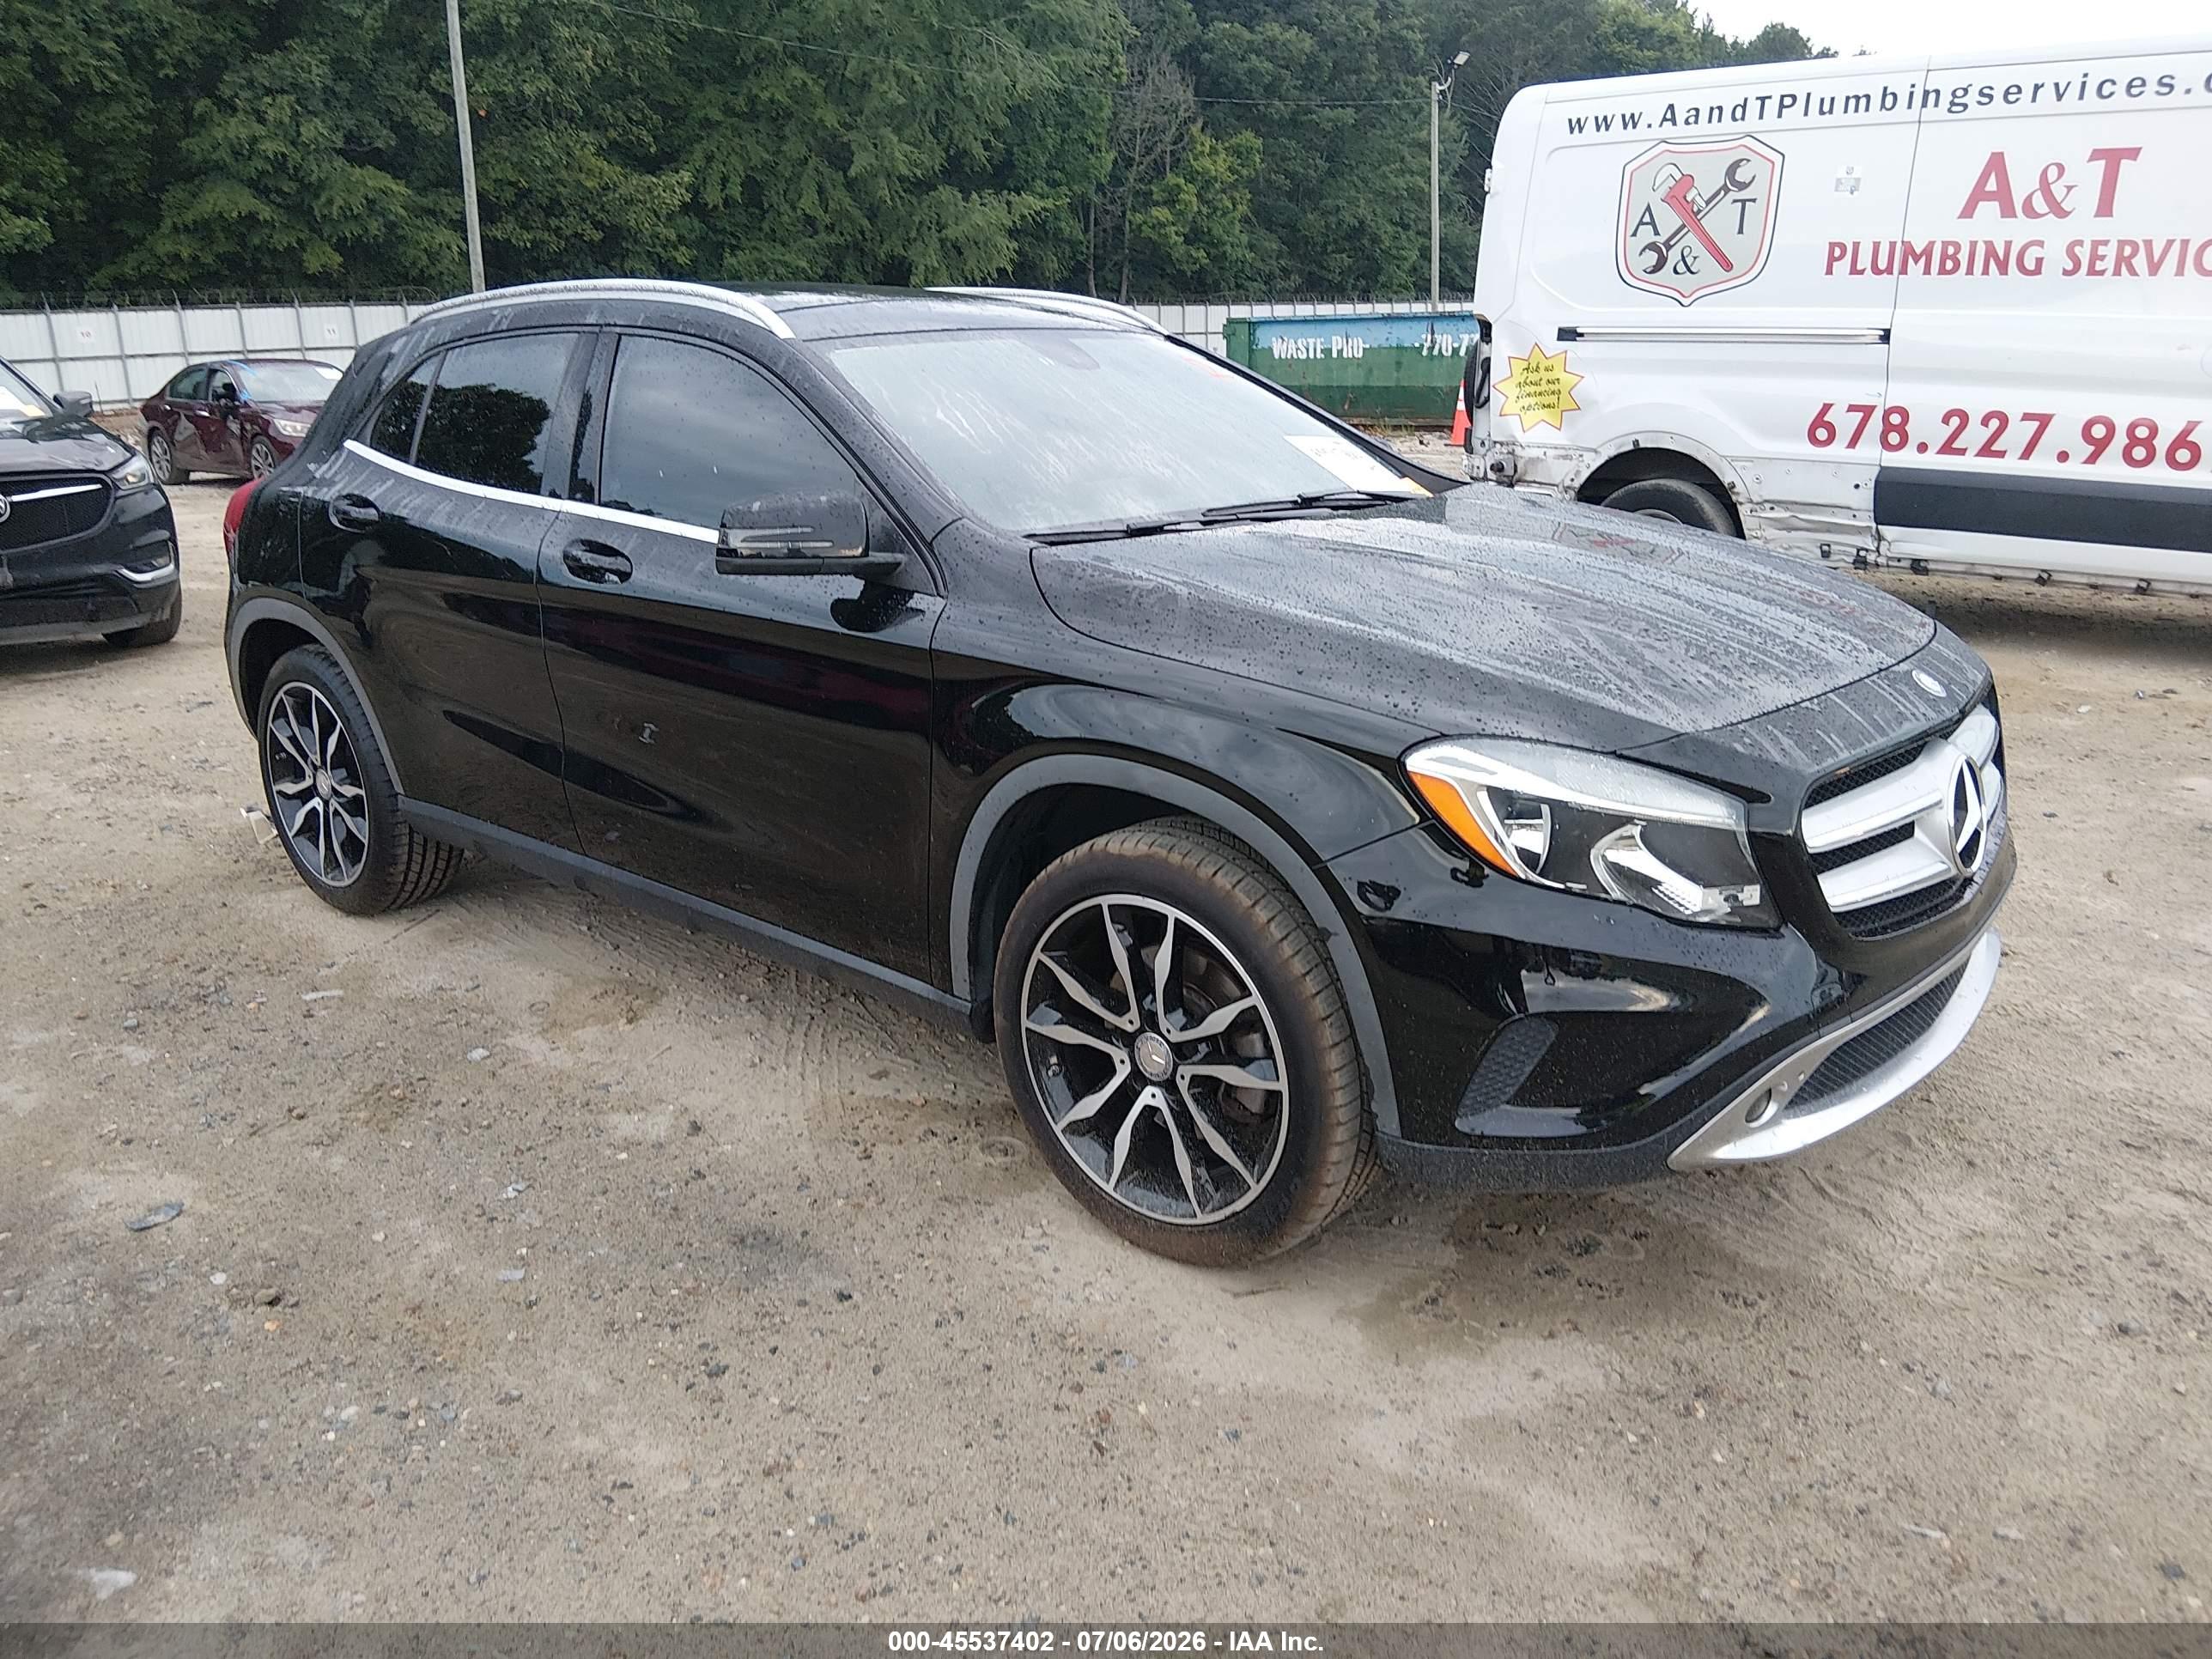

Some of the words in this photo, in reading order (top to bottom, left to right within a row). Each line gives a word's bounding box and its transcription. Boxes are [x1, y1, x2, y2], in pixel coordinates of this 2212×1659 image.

[1957, 147, 2142, 220] A&T
[1630, 202, 1661, 237] A
[1730, 198, 1757, 235] T
[1825, 240, 2045, 276] PLUMBING
[1272, 336, 1325, 360] WASTE
[1516, 376, 1543, 390] about
[1545, 377, 1561, 386] our
[1520, 361, 1540, 376] Ask
[1543, 364, 1555, 373] us
